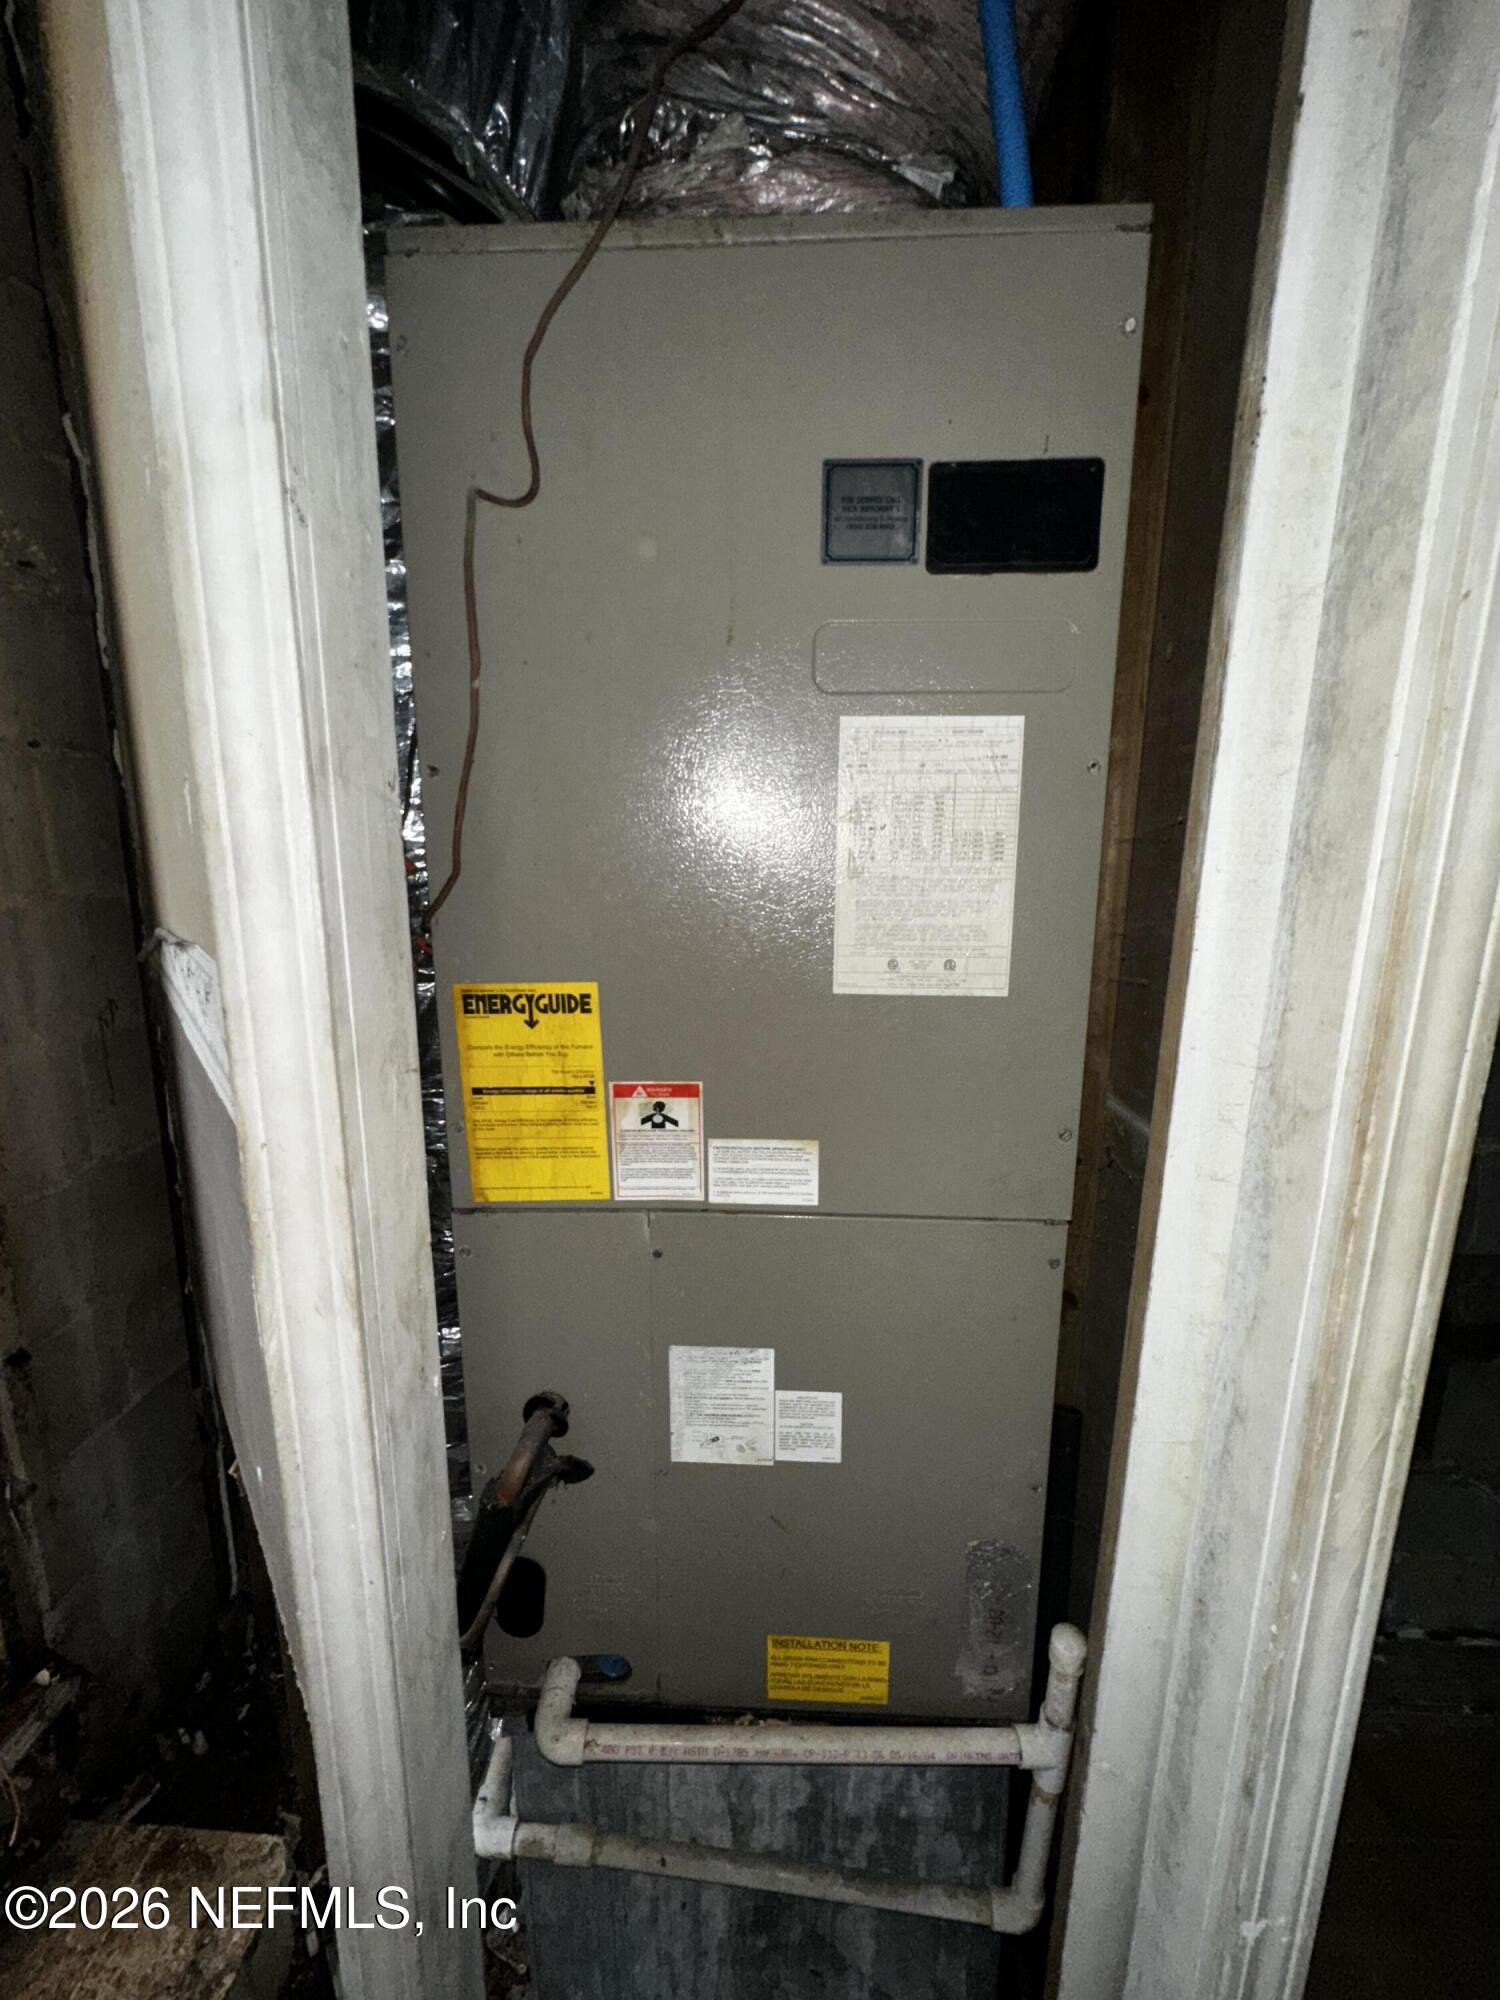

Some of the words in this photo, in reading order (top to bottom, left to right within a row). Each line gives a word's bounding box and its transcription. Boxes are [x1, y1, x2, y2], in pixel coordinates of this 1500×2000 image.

[461, 993, 593, 1017] ENERGYGUIDE
[771, 1639, 847, 1652] INSTALLATION
[848, 1642, 879, 1653] NOTE
[625, 1745, 643, 1756] PSI
